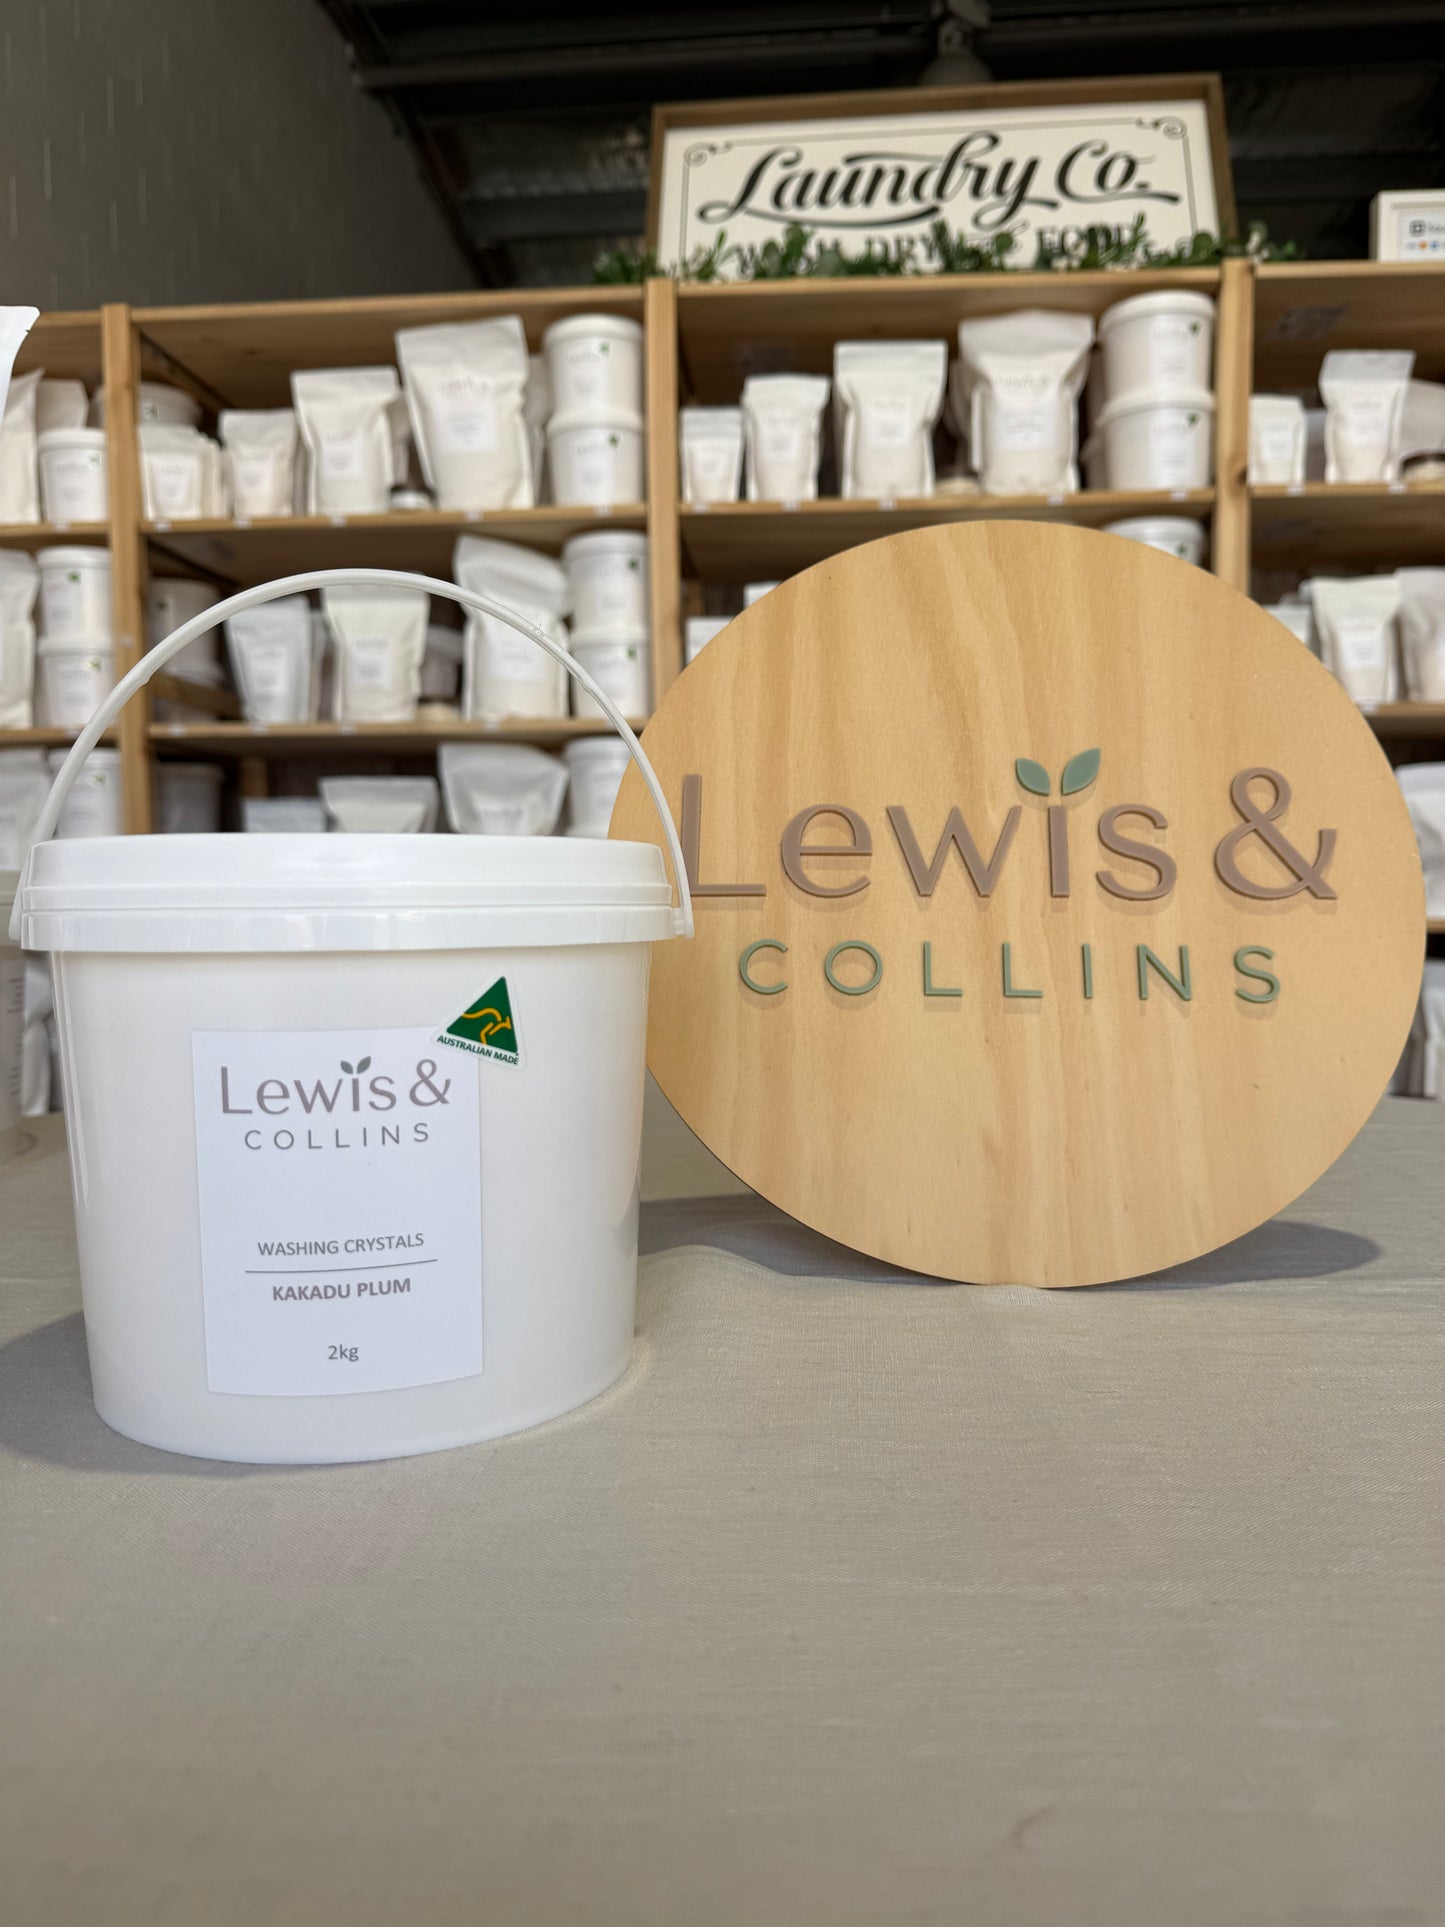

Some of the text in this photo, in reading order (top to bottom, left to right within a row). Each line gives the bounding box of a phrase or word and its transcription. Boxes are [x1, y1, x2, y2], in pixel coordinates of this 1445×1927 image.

[697, 130, 1179, 231] Laundry Co.
[682, 748, 1337, 901] Lewis &
[739, 939, 1281, 1003] COLLINS
[436, 1035, 519, 1065] AUSTRALIAN MADE
[220, 1055, 452, 1115] Lewis &
[244, 1122, 429, 1150] COLLINS
[257, 1232, 425, 1256] WASHING CRYSTALS
[272, 1277, 411, 1301] KAKADU PLUM
[327, 1344, 359, 1362] 2kg
